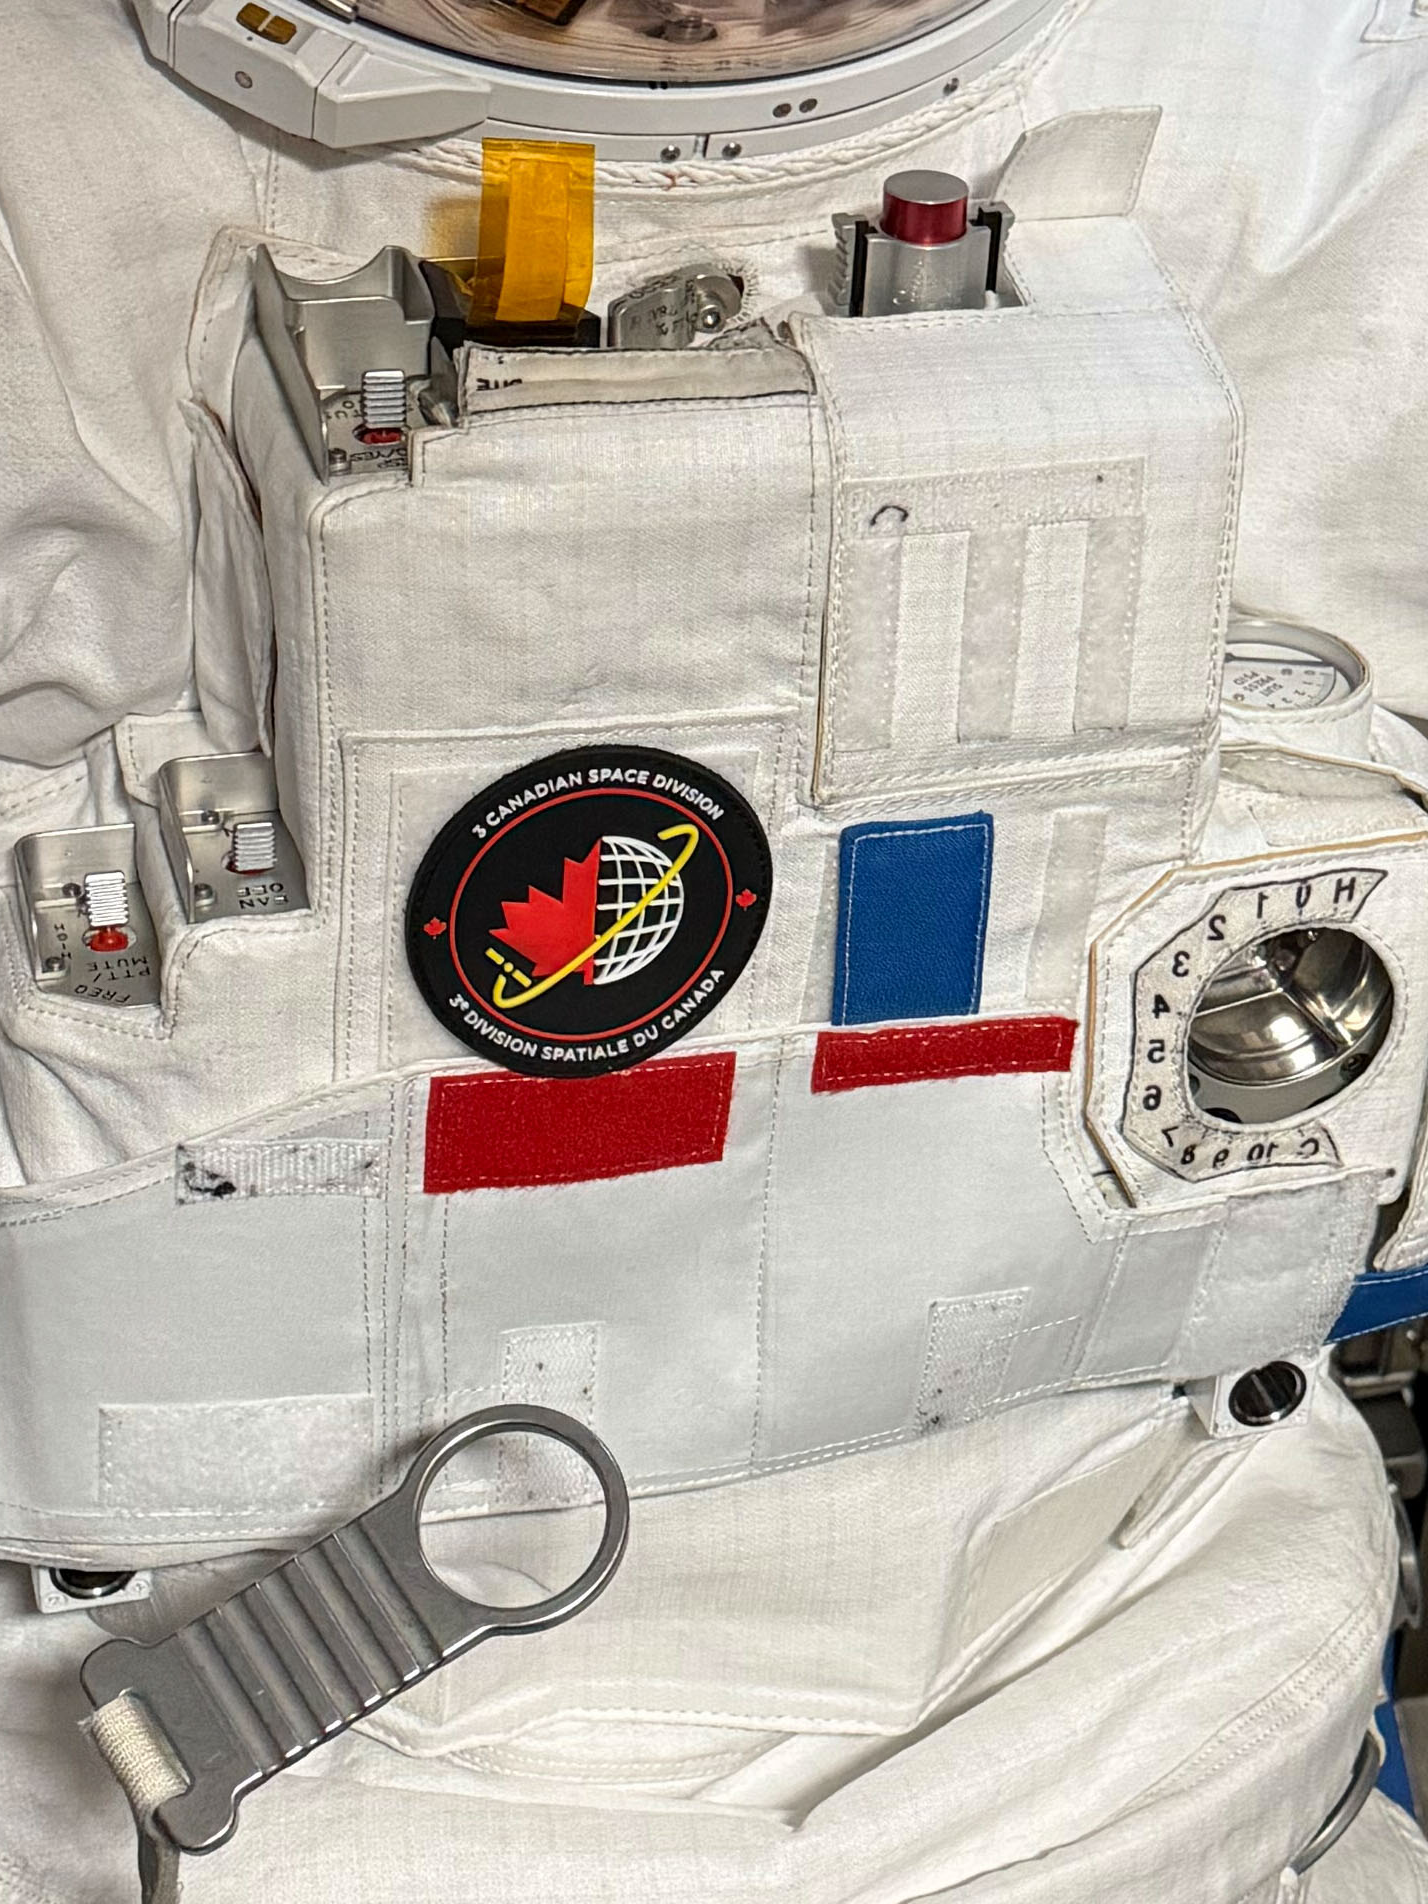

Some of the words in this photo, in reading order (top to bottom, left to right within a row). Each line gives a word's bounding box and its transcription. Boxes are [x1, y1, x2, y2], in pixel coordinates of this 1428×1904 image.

[471, 823, 488, 840] 3
[485, 771, 584, 829] CANADIAN
[587, 767, 650, 786] SPACE
[651, 773, 725, 822] DIVISION
[237, 882, 285, 899] OFF
[238, 894, 288, 909] FAN
[87, 957, 149, 973] MUTE
[93, 967, 152, 983] PTT/
[75, 983, 132, 1005] FREQ
[464, 1010, 539, 1059] DIVISION
[539, 1039, 630, 1064] SPATIALE
[633, 1025, 659, 1049] DU
[660, 967, 726, 1032] CANADA
